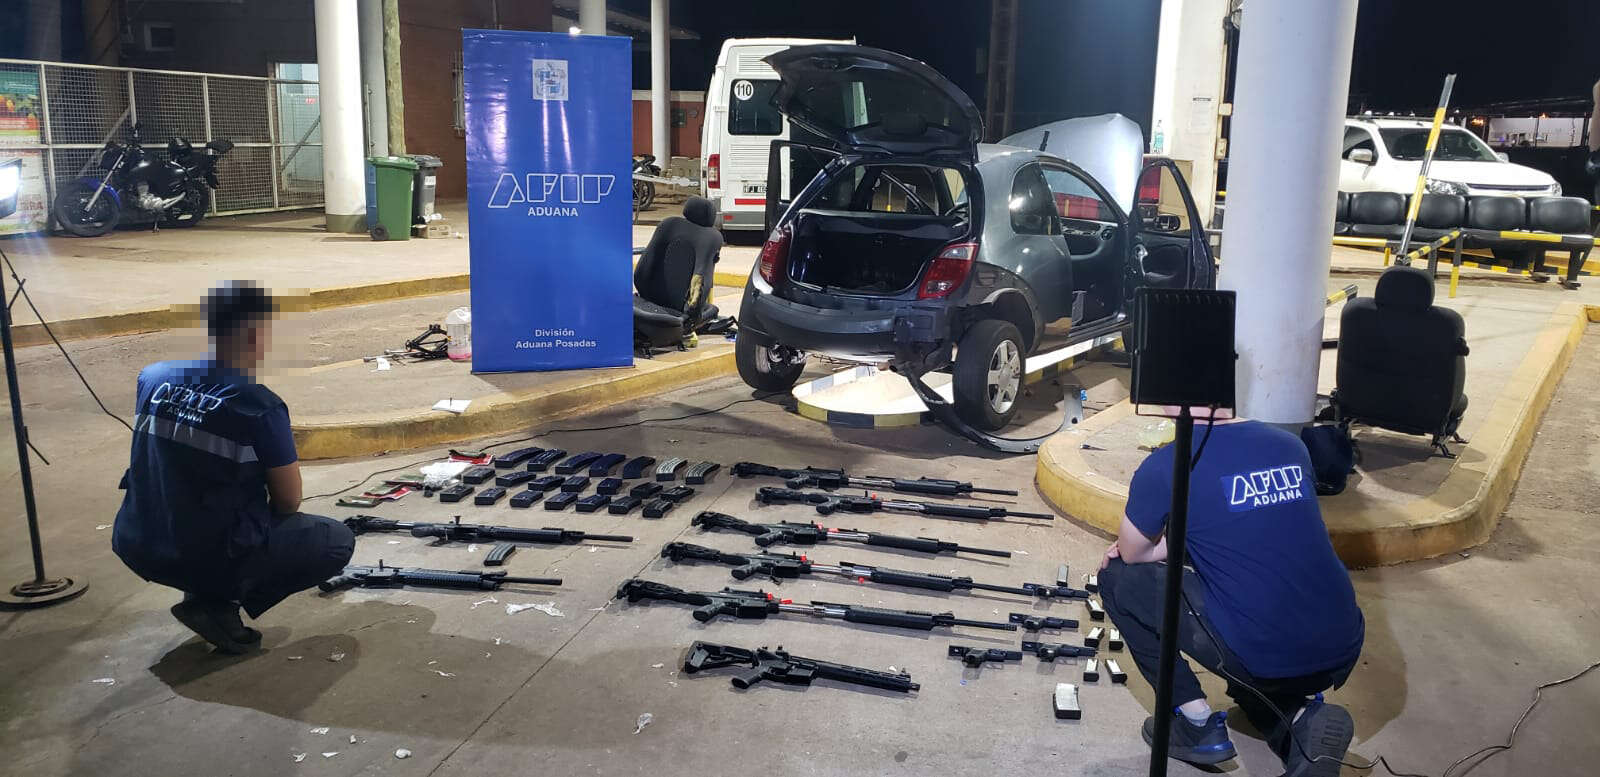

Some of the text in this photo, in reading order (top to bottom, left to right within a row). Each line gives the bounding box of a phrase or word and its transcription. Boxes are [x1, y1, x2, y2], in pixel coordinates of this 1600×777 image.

[736, 83, 752, 97] 110
[488, 173, 616, 208] AFIP
[527, 207, 579, 217] ADUANA
[535, 328, 575, 337] División
[515, 339, 597, 349] Aduana Posadas
[166, 406, 203, 423] ADUANA
[1230, 465, 1303, 505] AFIP
[1253, 488, 1303, 507] ADUANA
